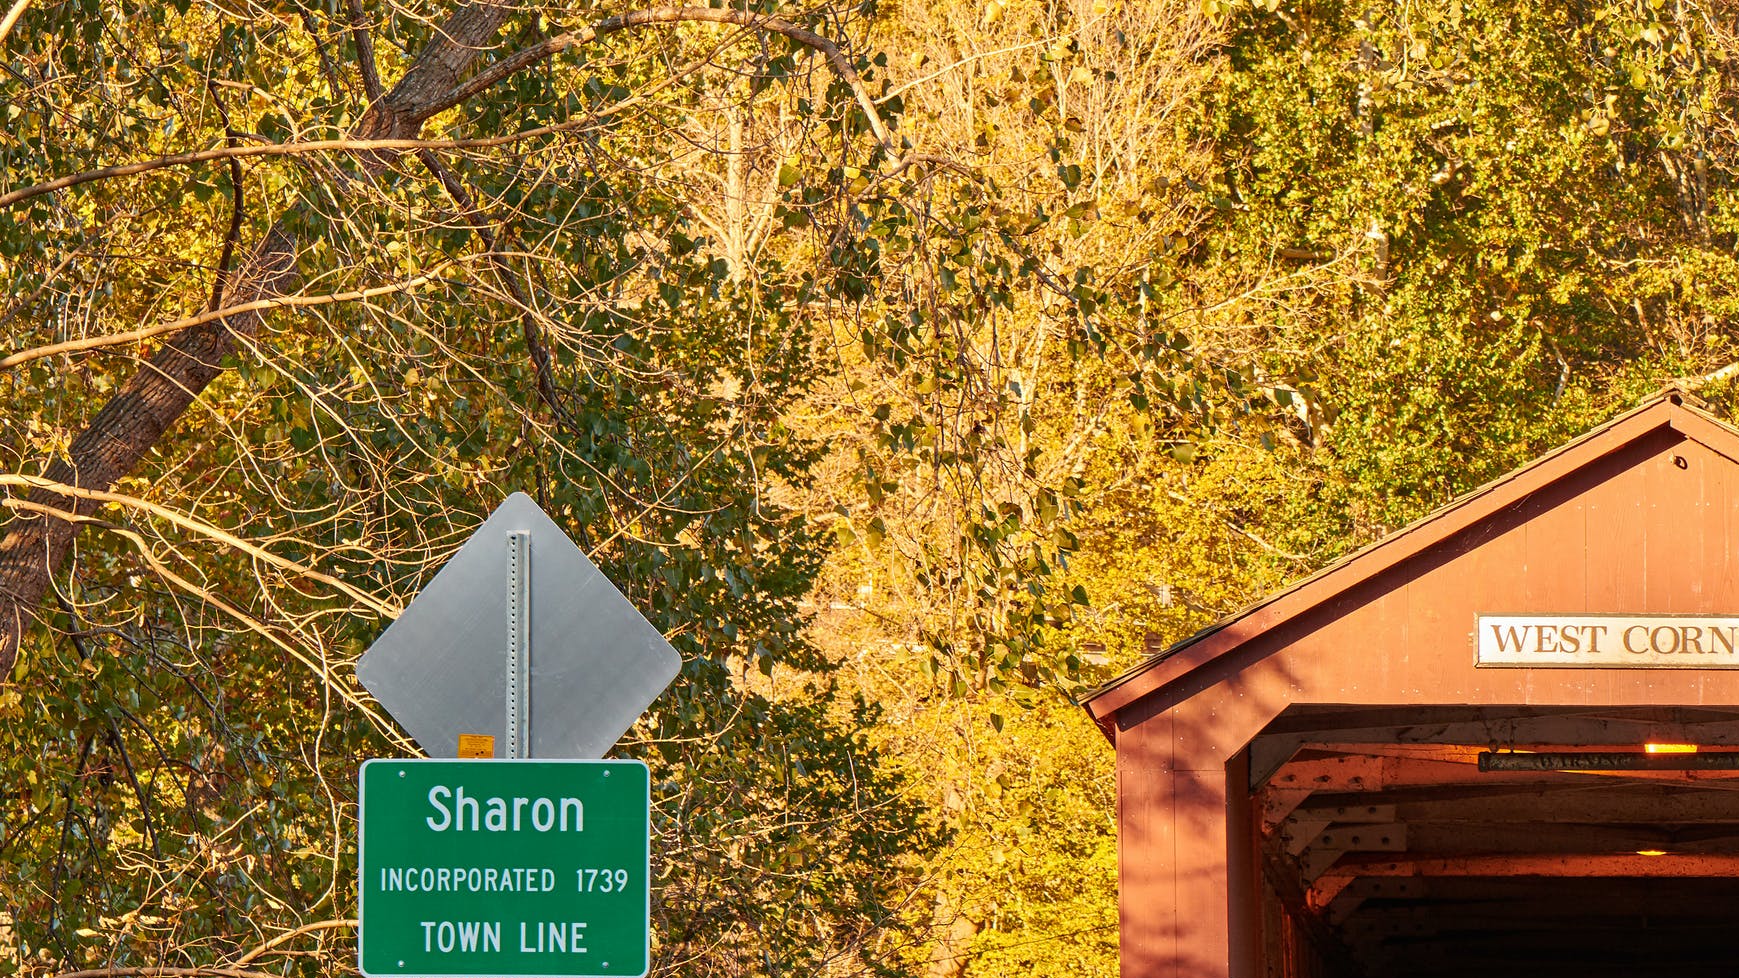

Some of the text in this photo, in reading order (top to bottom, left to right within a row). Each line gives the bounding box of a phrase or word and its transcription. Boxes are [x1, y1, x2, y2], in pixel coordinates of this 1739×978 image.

[1490, 624, 1608, 654] WEST
[426, 785, 584, 832] Sharon
[381, 868, 629, 893] INCORPORATED 1739
[421, 921, 588, 953] TOWN LINE
